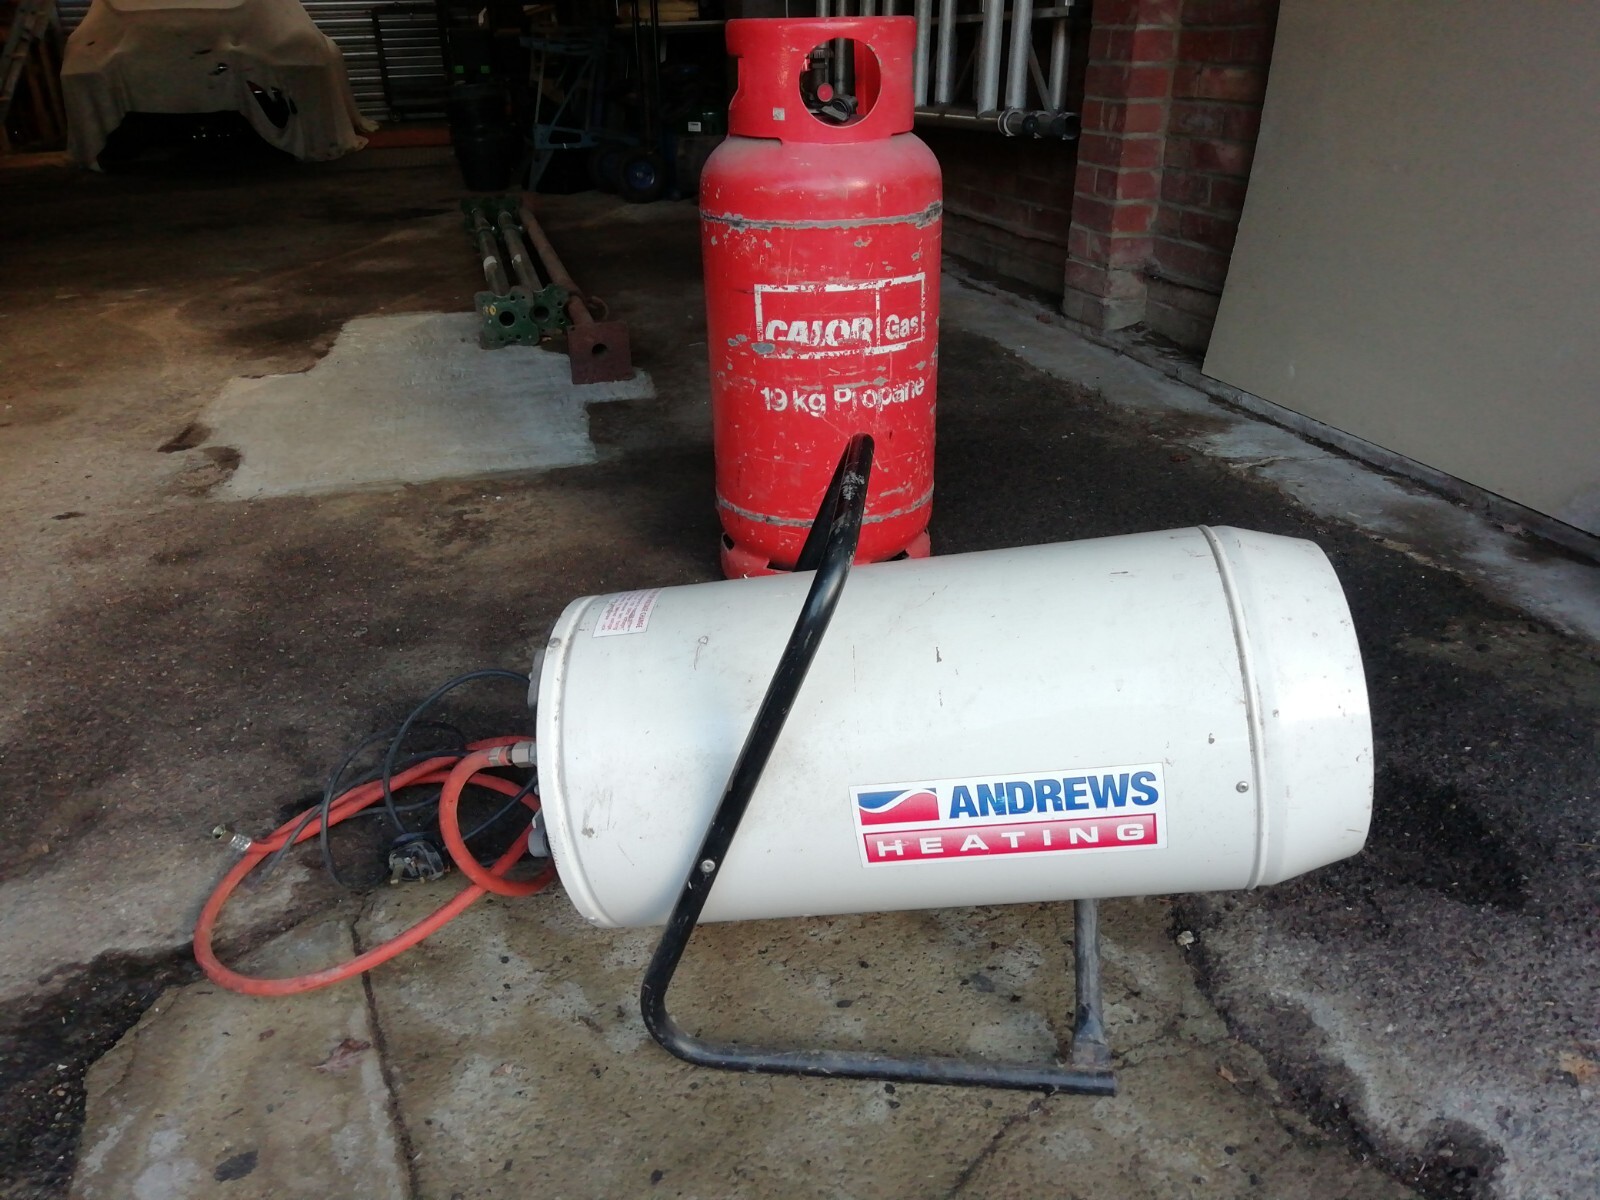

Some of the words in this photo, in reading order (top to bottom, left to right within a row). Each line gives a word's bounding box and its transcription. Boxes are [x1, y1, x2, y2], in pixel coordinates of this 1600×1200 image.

[765, 317, 873, 347] CALOR
[885, 314, 919, 340] Gas
[761, 387, 788, 411] 19
[792, 388, 827, 417] kg
[834, 377, 925, 412] Propane
[949, 771, 1159, 819] ANDREWS
[876, 823, 1145, 857] HEATING
